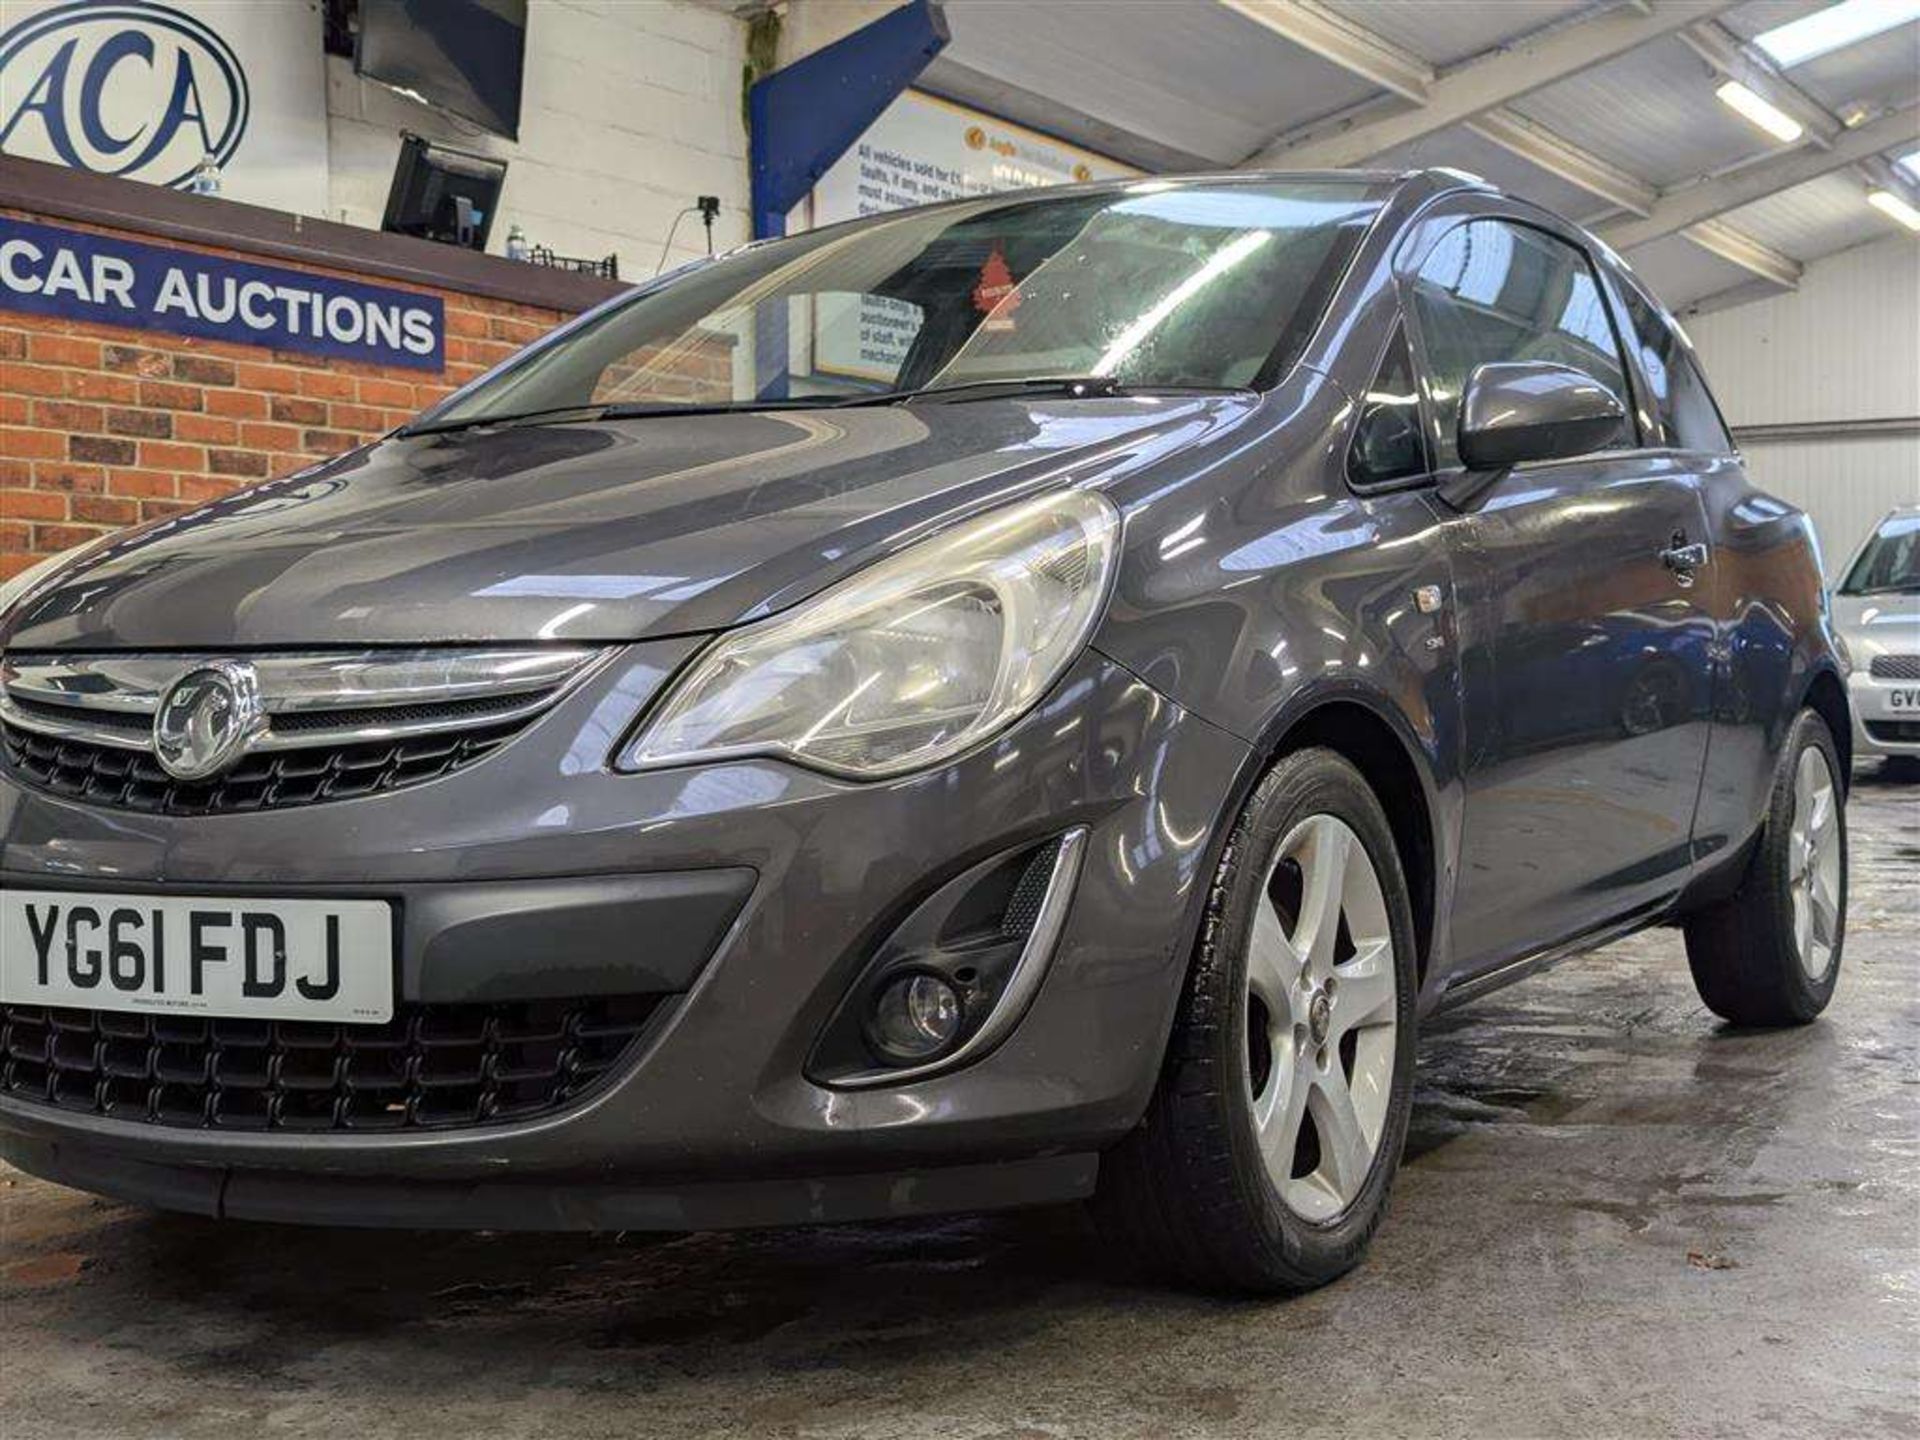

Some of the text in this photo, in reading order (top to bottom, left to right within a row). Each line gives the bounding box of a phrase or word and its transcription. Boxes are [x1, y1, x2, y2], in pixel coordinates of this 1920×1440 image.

[0, 29, 212, 176] ACA
[873, 150, 912, 173] vehicles
[914, 162, 935, 179] sold
[0, 239, 437, 356] CAR AUCTIONS
[1891, 689, 1920, 707] GV
[25, 903, 340, 1001] YG61 FDJ
